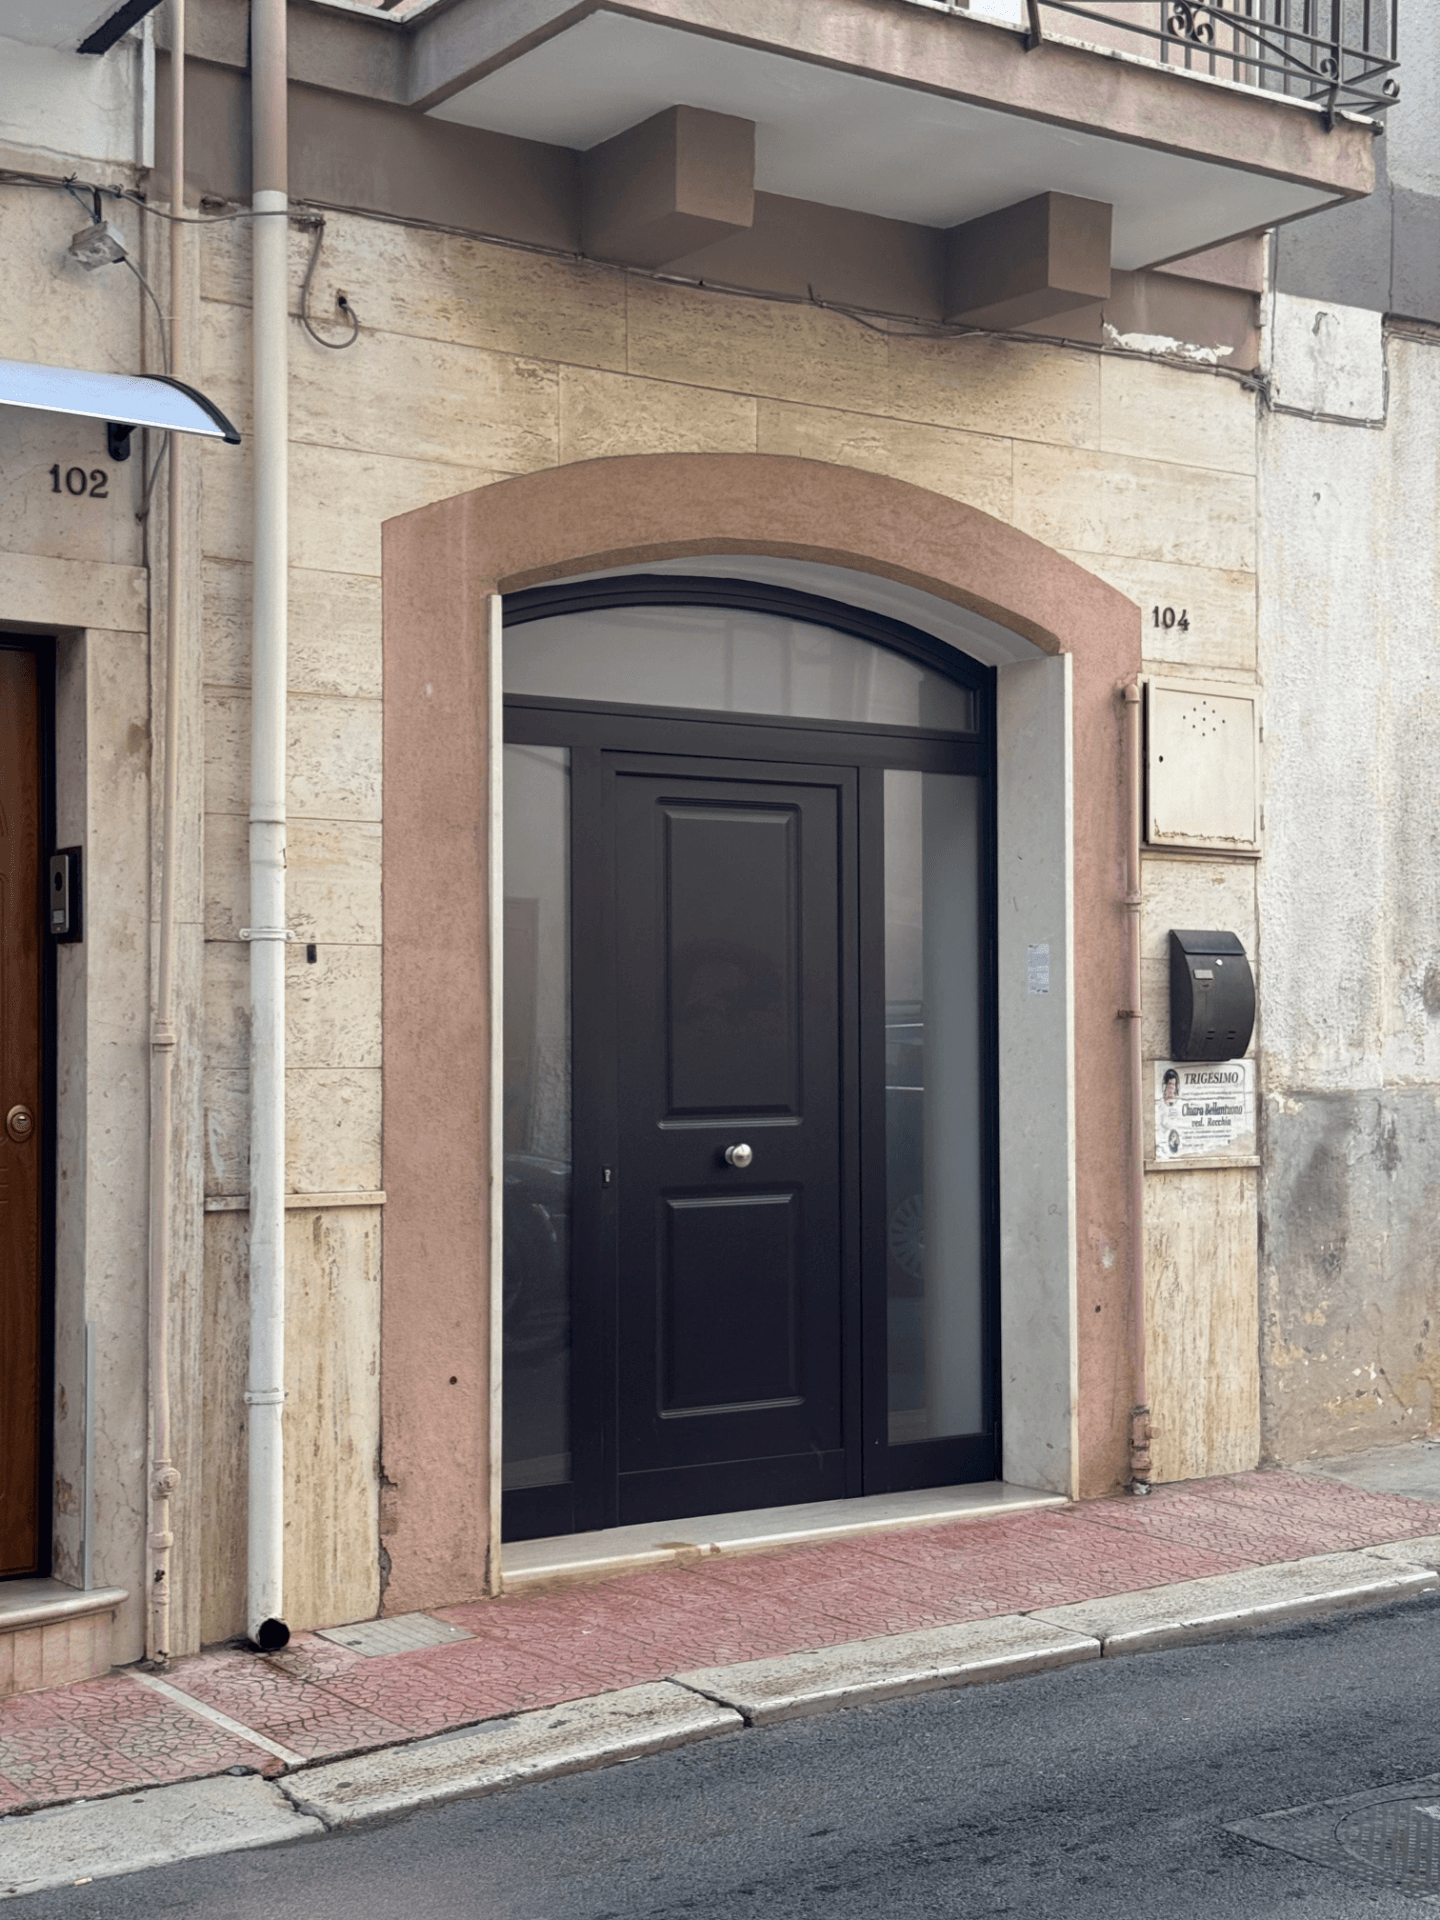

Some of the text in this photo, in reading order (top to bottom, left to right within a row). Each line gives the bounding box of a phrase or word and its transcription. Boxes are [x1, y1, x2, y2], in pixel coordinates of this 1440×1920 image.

[49, 463, 109, 498] 102
[1152, 605, 1190, 632] 104
[1184, 1072, 1239, 1085] TRIGESIMO
[1181, 1103, 1204, 1117] Chiara
[1207, 1116, 1231, 1127] Recchia
